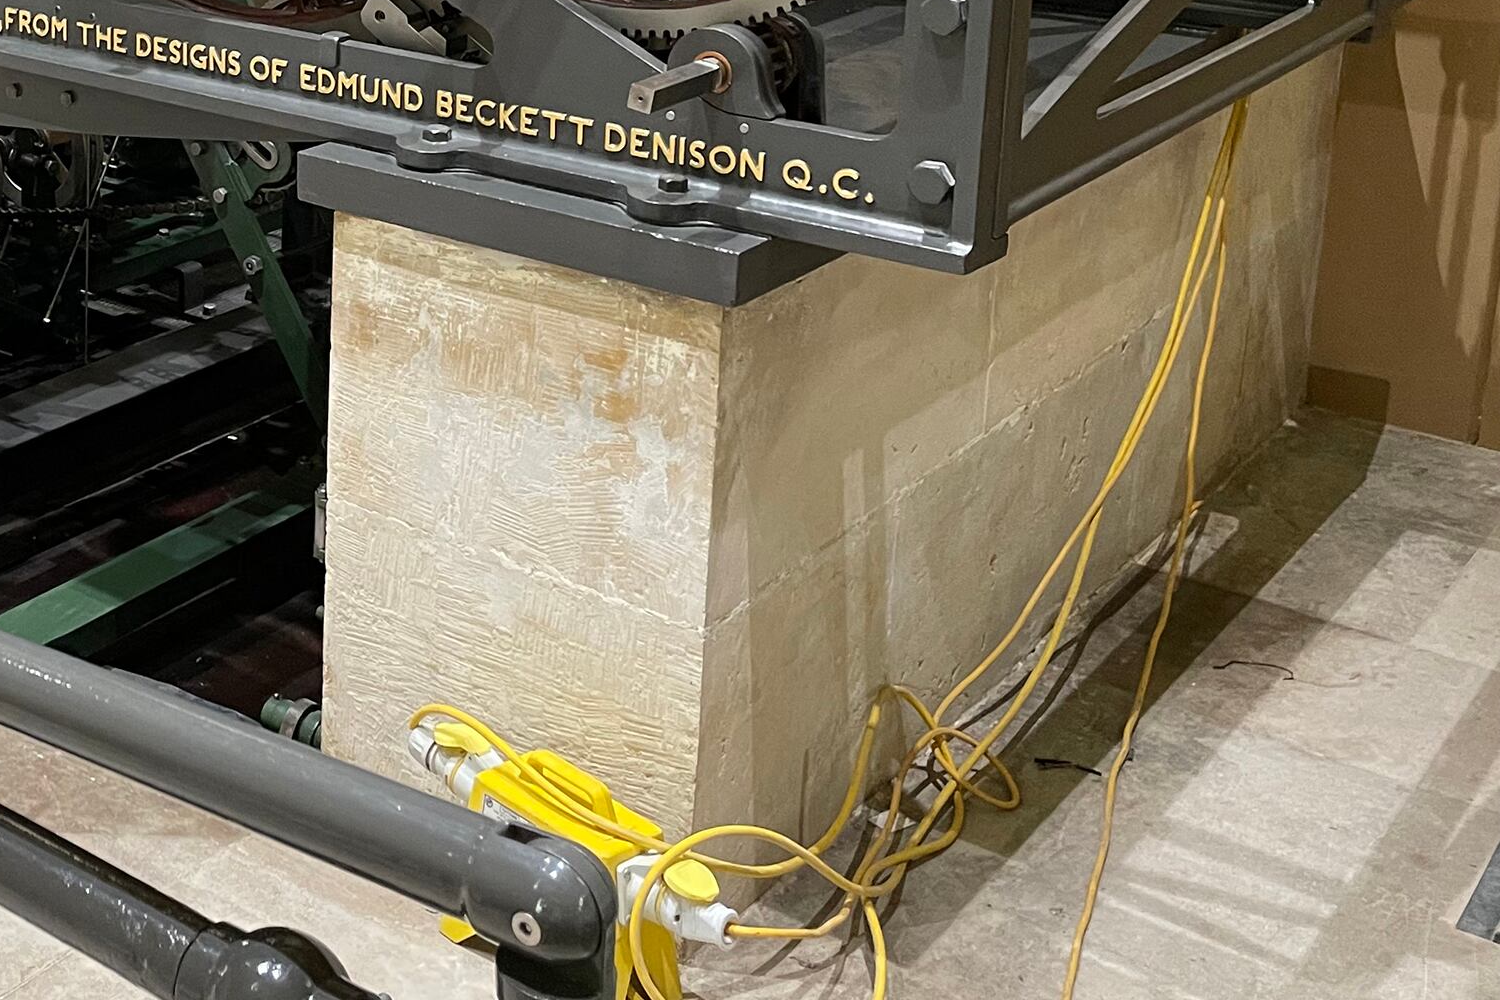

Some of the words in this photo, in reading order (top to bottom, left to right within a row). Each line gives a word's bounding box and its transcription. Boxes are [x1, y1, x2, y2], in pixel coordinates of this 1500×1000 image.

[4, 6, 68, 42] FROM
[76, 21, 128, 54] THE
[135, 32, 242, 77] DESIGNS
[249, 55, 288, 84] OF
[299, 62, 424, 113] EDMUND
[435, 89, 595, 146] BECKETT
[603, 122, 767, 183] DENISON
